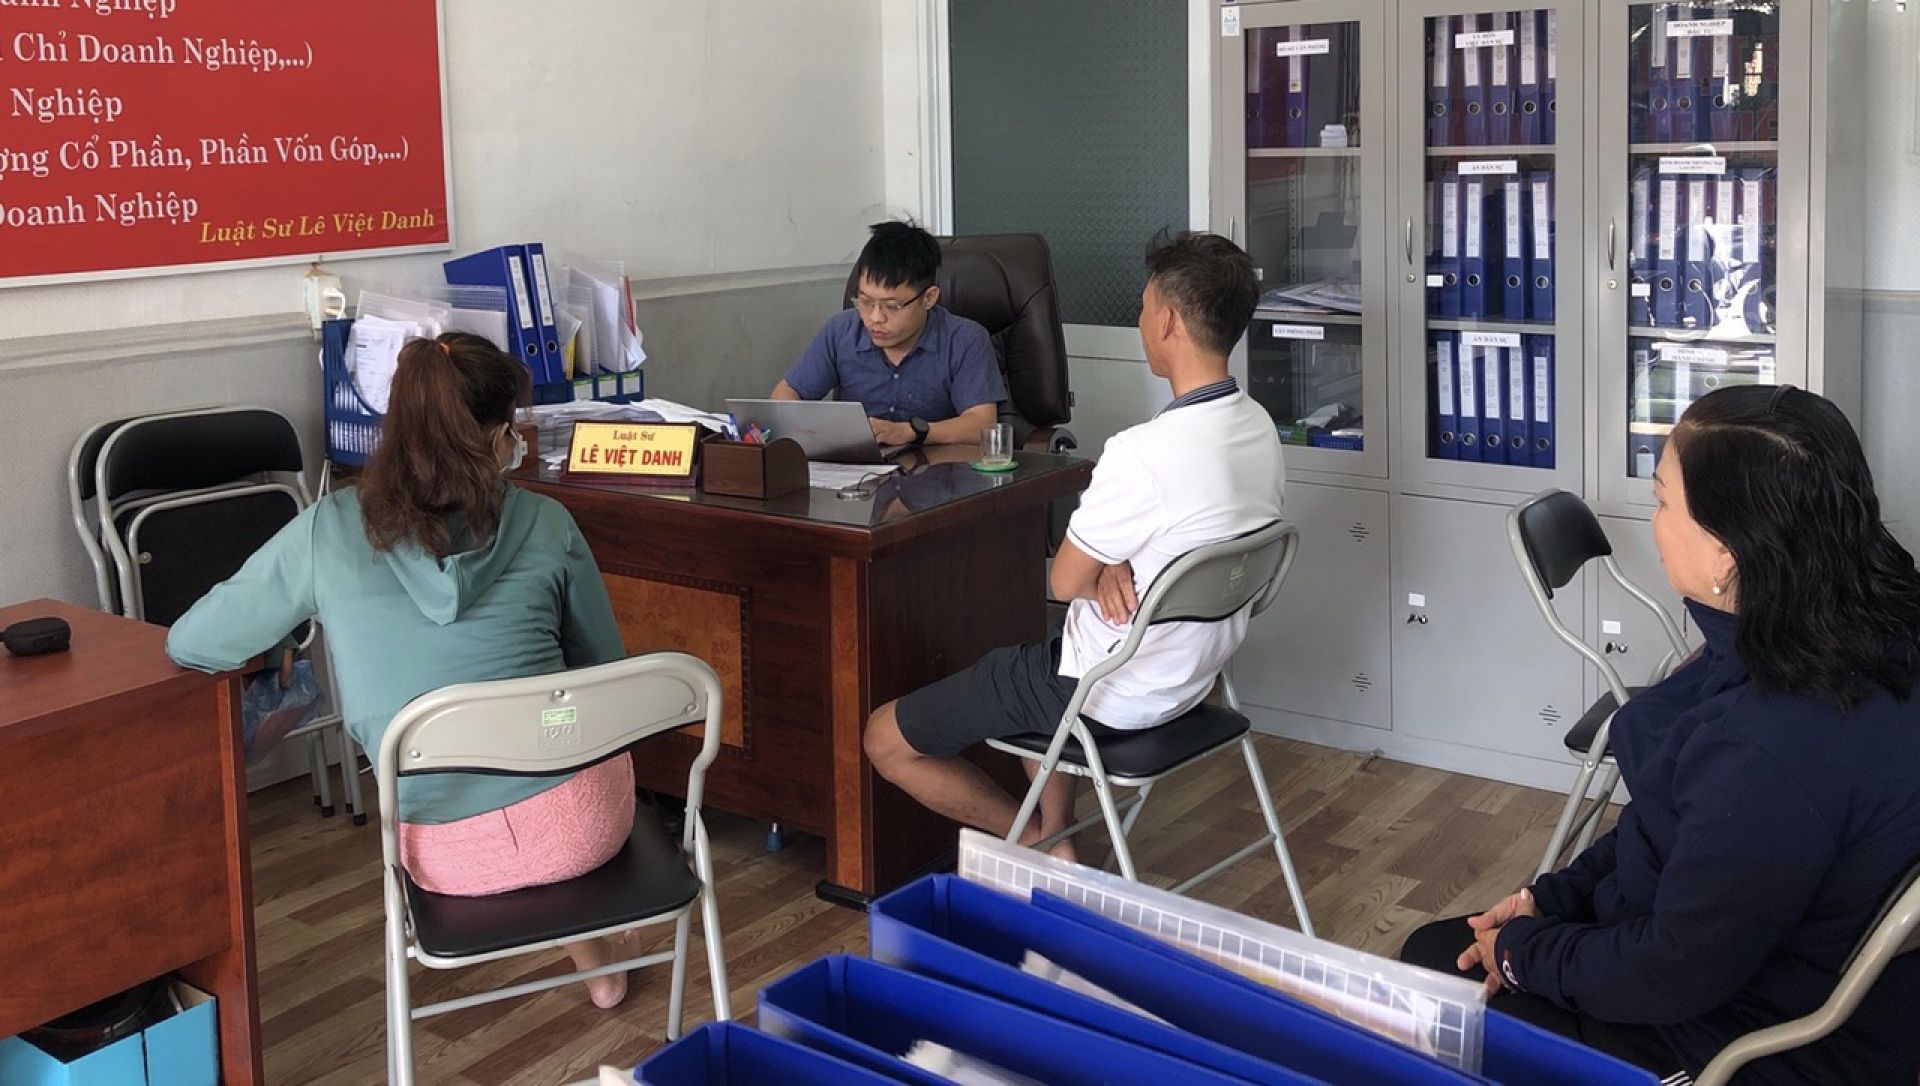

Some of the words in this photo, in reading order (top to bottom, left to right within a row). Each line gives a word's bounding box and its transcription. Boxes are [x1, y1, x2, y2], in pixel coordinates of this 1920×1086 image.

[13, 29, 69, 62] Chỉ
[77, 34, 175, 64] Doanh
[182, 37, 313, 73] Nghiệp,...)
[10, 87, 122, 124] Nghiệp
[59, 134, 100, 170] Cổ
[108, 134, 192, 171] Phần,
[199, 133, 268, 165] Phần
[273, 133, 323, 162] Vốn
[329, 135, 409, 165] Góp,...)
[0, 195, 86, 227] oanh
[94, 191, 198, 226] Nghiệp
[199, 220, 255, 247] Luật
[262, 217, 294, 239] Sư
[300, 215, 325, 236] Lê
[333, 213, 374, 237] Việt
[381, 208, 435, 230] Danh
[612, 430, 637, 442] Luật
[640, 431, 656, 441] Sư
[580, 443, 599, 464] LÊ
[604, 444, 638, 468] VIỆT
[641, 449, 682, 466] DANH
